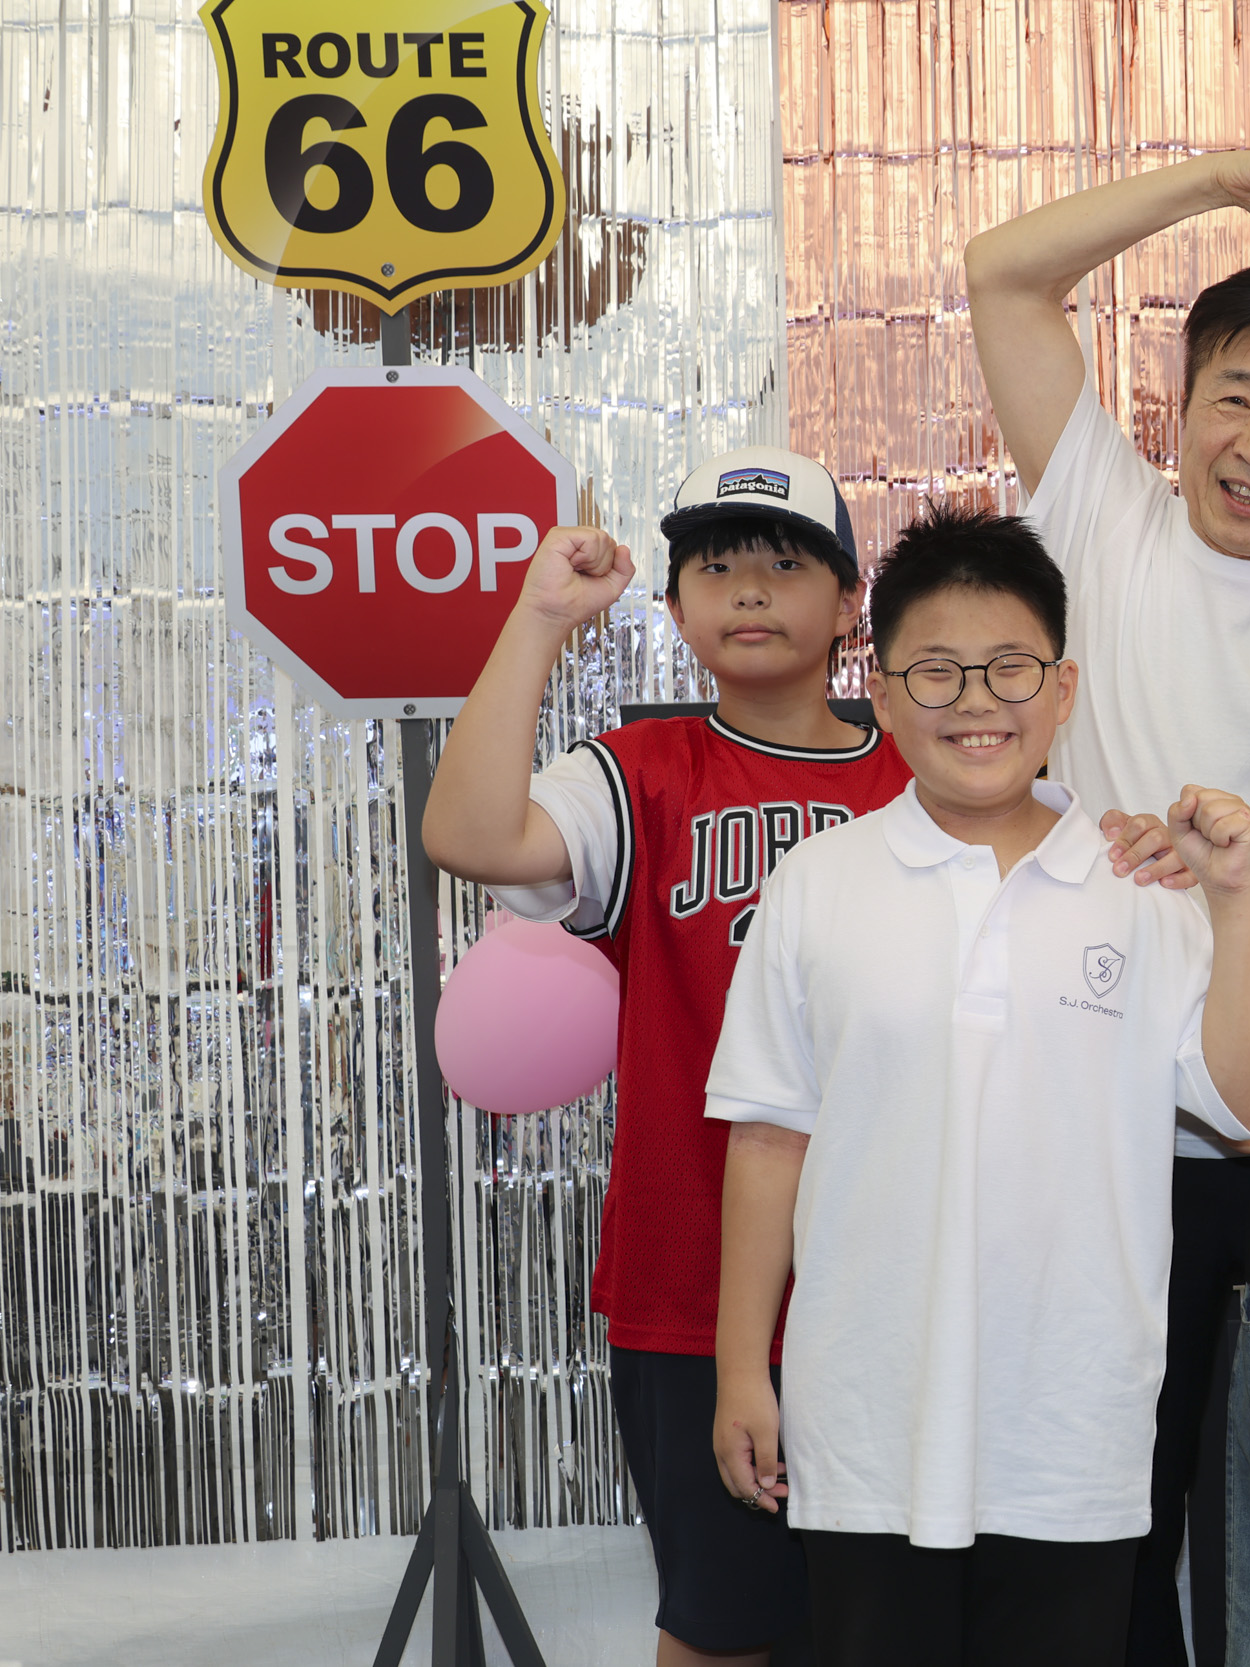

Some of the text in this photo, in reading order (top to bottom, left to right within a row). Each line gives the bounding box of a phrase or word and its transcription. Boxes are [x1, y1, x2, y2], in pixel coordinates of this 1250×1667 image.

[262, 32, 487, 79] ROUTE
[264, 93, 495, 234] 66
[719, 481, 785, 496] patagonia
[267, 512, 539, 596] STOP
[1059, 996, 1124, 1019] S.J. Orchestra
